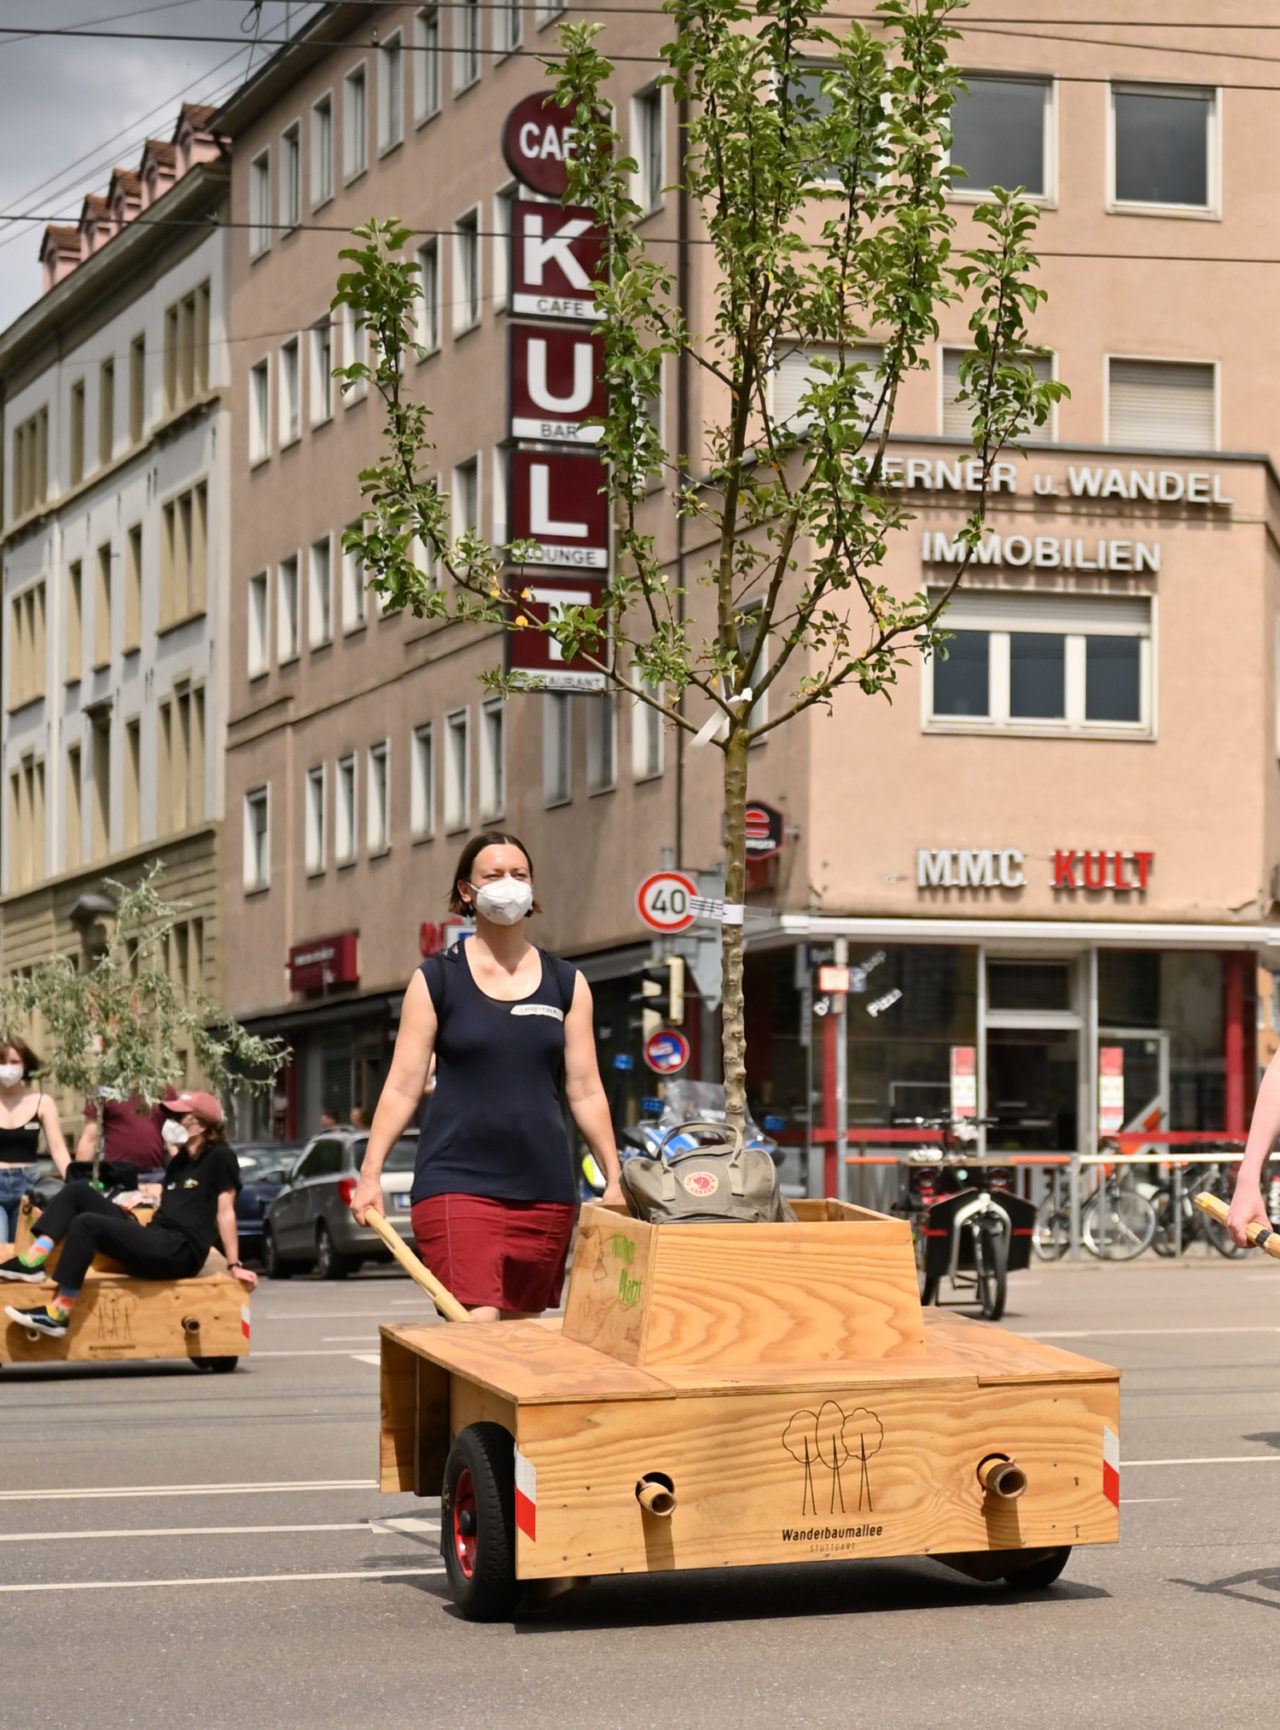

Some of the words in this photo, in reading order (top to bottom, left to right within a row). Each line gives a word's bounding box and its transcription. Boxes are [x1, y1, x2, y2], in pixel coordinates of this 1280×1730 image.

[519, 120, 598, 163] CAF
[536, 298, 584, 316] CAFE
[541, 423, 577, 438] BAR
[1069, 466, 1234, 504] WANDEL
[921, 531, 1162, 572] IMMOBILIEN
[918, 848, 1024, 887] MMC
[1053, 849, 1154, 890] KULT
[651, 889, 686, 914] 40
[782, 1523, 883, 1541] Wanderbaumallee
[810, 1542, 856, 1552] STUTTGART
